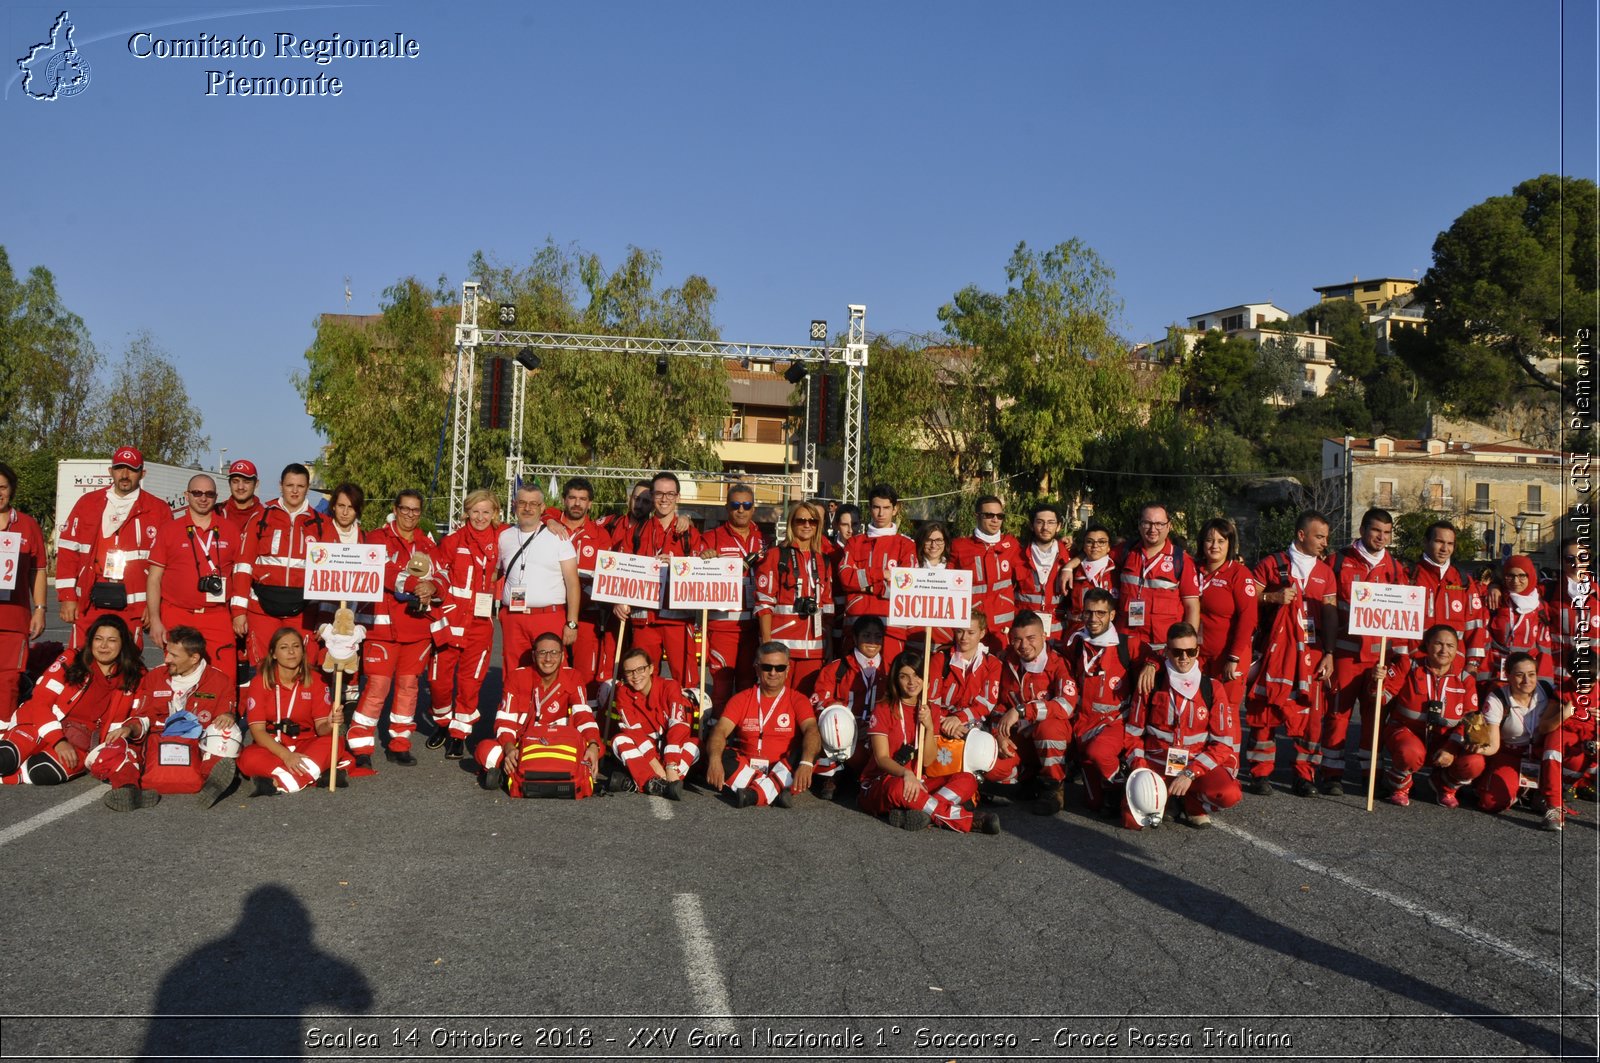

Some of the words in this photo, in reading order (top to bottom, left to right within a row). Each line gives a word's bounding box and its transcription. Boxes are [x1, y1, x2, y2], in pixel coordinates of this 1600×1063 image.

[3, 558, 14, 582] 2
[308, 569, 380, 594] ABRUZZO
[596, 574, 662, 601] PIEMONTE
[673, 581, 739, 603] LOMBARDIA
[893, 594, 955, 620] SICILIA
[961, 597, 968, 620] 1
[1354, 606, 1420, 632] TOSCANA
